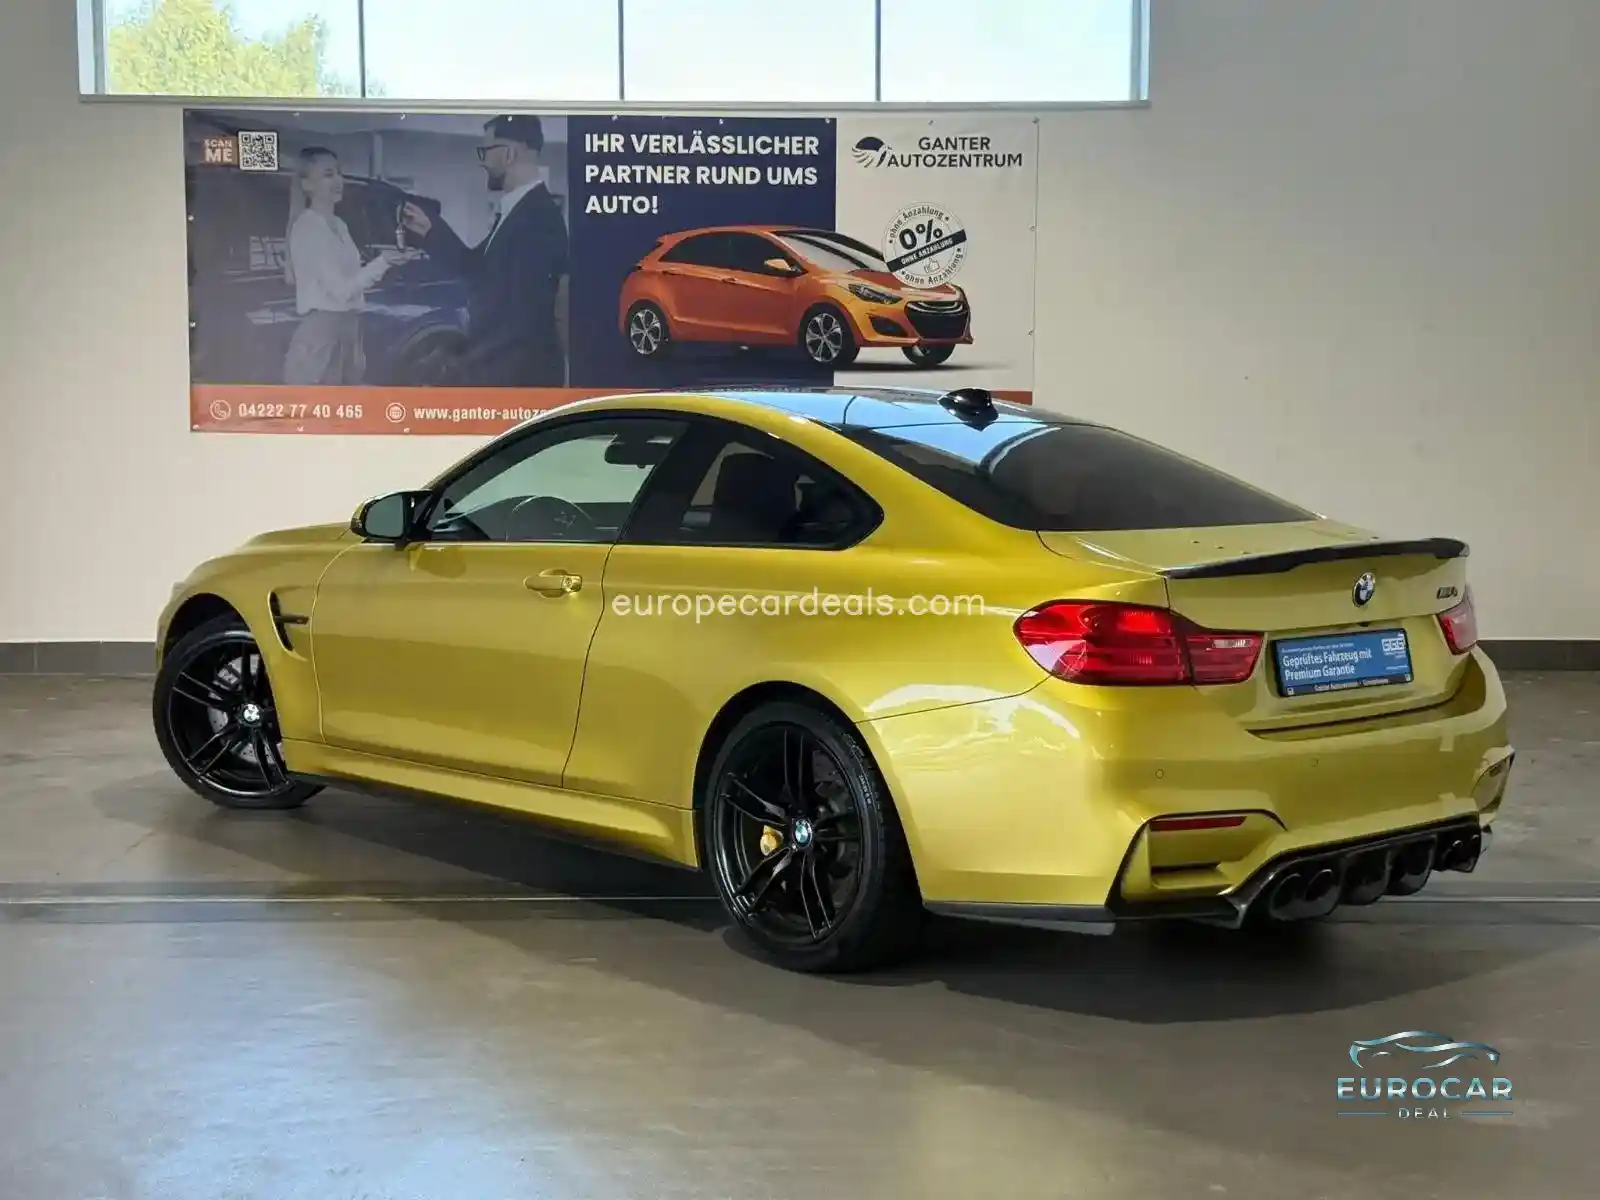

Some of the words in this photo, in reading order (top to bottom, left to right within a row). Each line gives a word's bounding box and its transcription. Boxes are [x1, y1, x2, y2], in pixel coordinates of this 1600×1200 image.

[585, 133, 625, 153] IHR
[630, 130, 820, 156] VERLÄSSLICHER
[918, 136, 991, 151] GANTER
[205, 148, 233, 163] ME
[887, 153, 1023, 168] AUTOZENTRUM
[585, 165, 691, 185] PARTNER
[696, 166, 762, 185] RUND
[766, 167, 818, 186] UMS
[585, 195, 659, 214] AUTO!
[898, 217, 943, 250] 0%
[238, 403, 284, 418] 04222
[289, 404, 306, 418] 77
[312, 405, 331, 418] 40
[335, 404, 363, 418] 465
[1282, 653, 1323, 669] Geprüftes
[1323, 649, 1359, 663] Fahrzeug
[1359, 648, 1372, 659] mit
[1284, 667, 1322, 681] Premium
[1322, 663, 1356, 677] Garantie
